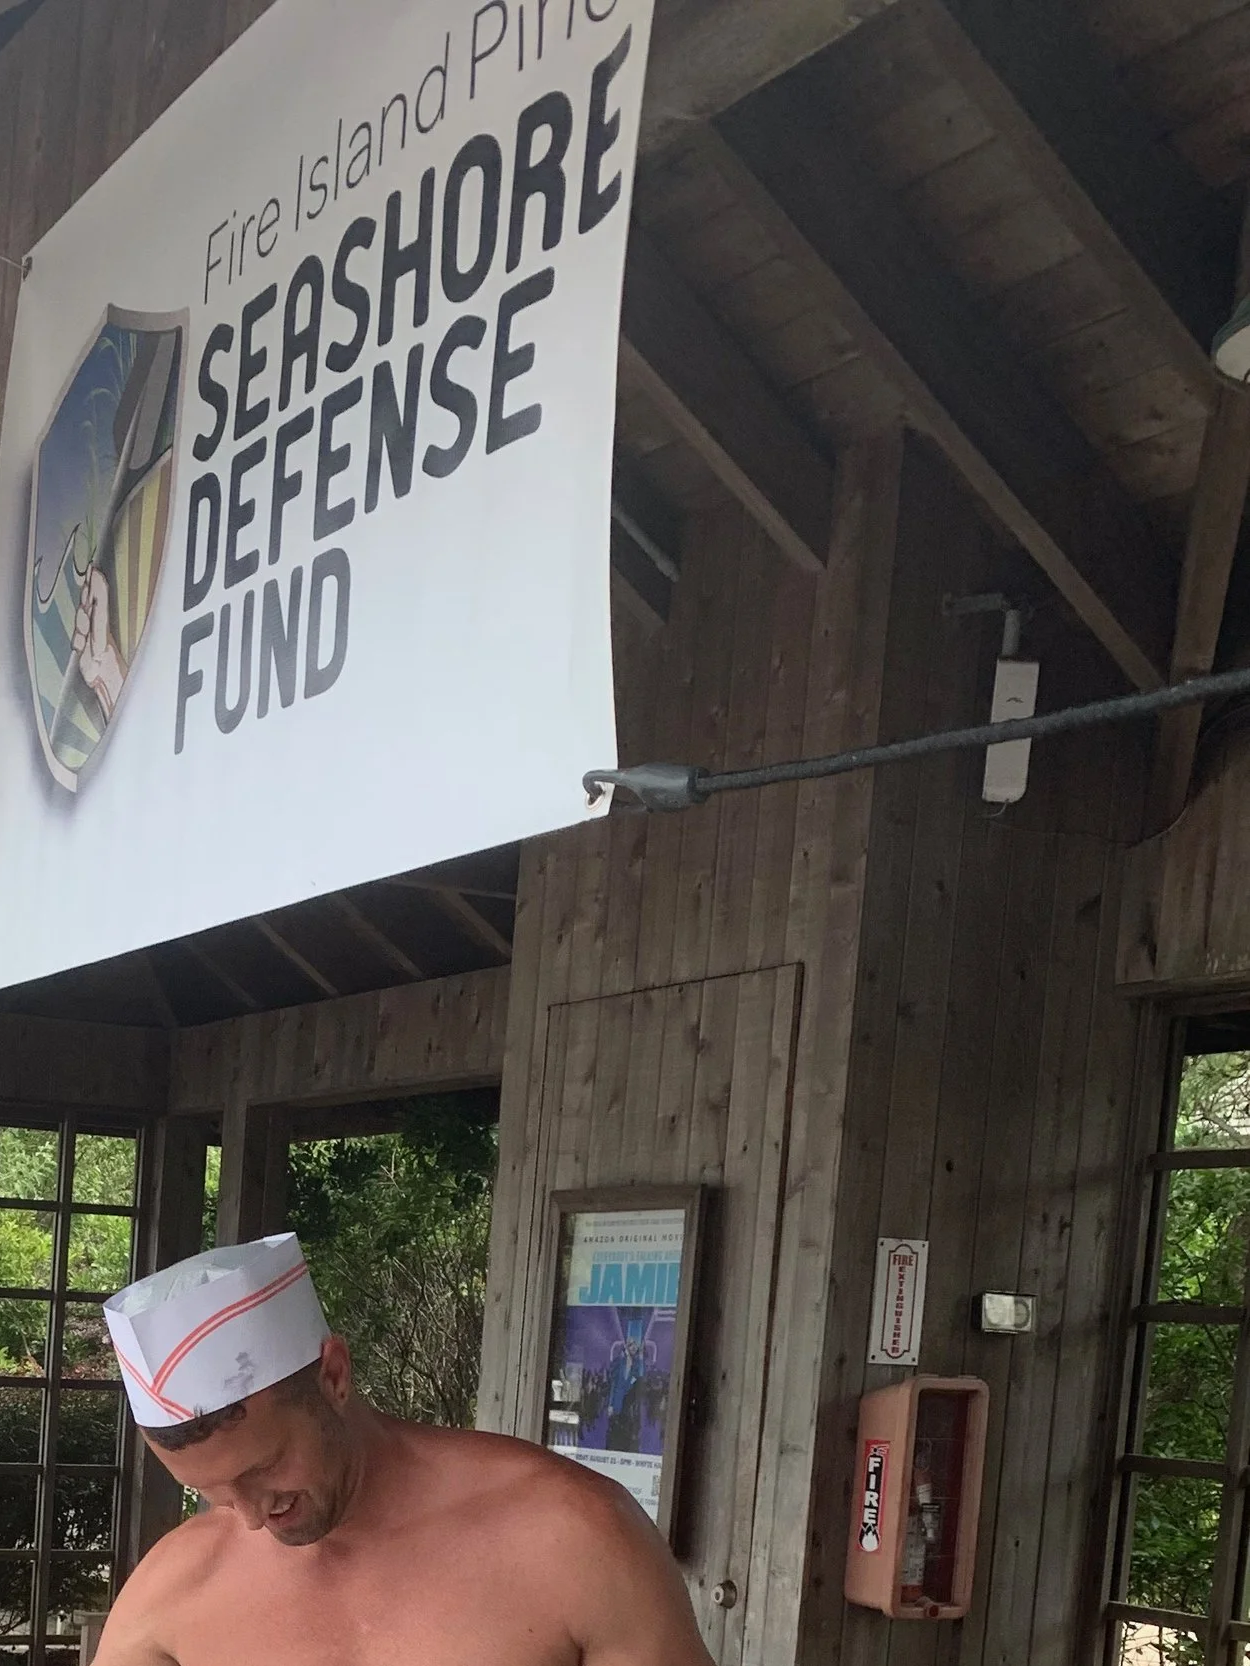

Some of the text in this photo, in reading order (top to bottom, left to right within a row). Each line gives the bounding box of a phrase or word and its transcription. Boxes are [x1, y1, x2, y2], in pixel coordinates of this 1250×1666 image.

[204, 198, 278, 304] Fire
[295, 34, 450, 231] Island
[192, 24, 631, 464] SEASHORE
[183, 267, 555, 612] DEFENSE
[174, 547, 350, 755] FUND
[583, 1234, 615, 1243] AMAZON
[619, 1233, 657, 1243] ORIGINAL
[891, 1266, 906, 1353] EXTINGUISHER
[893, 1254, 913, 1266] FIRE
[863, 1456, 881, 1525] FIRE
